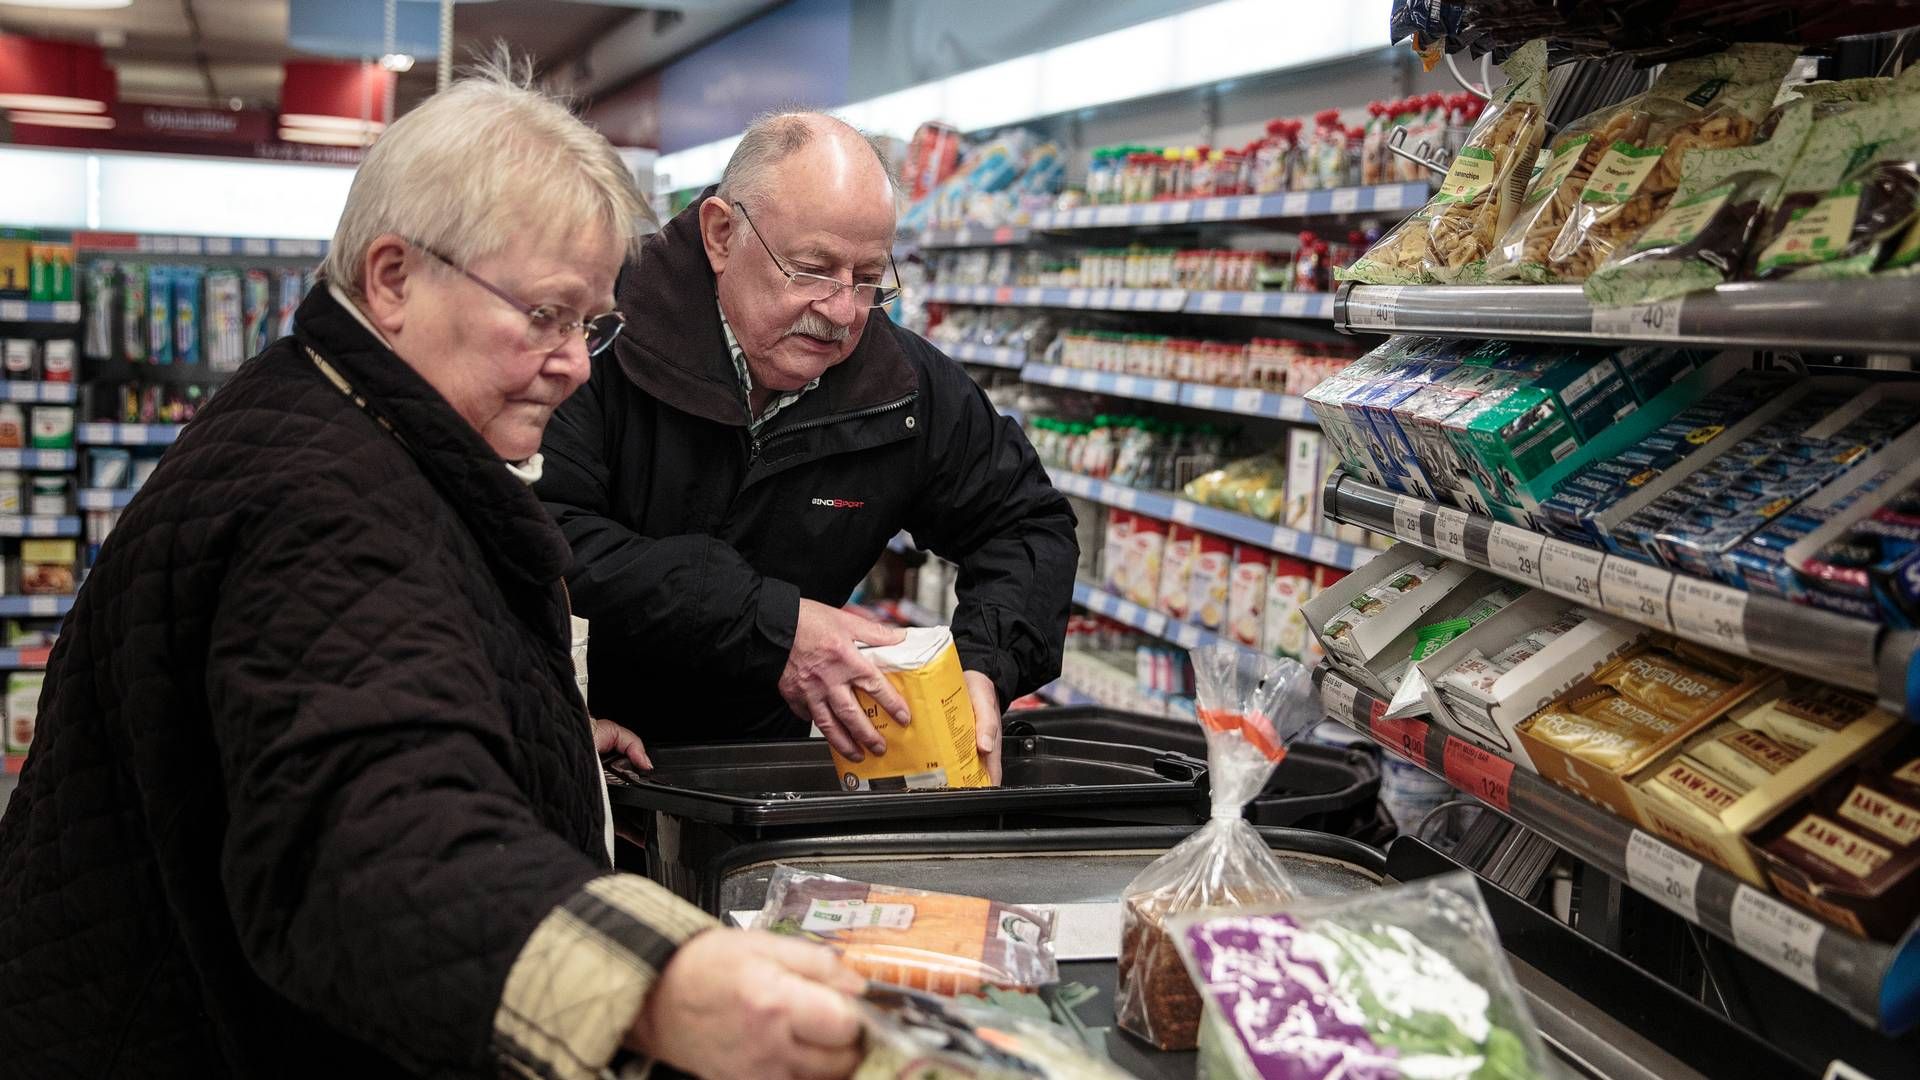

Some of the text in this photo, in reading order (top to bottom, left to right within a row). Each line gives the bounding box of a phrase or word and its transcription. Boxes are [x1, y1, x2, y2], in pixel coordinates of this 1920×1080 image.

[1643, 305, 1664, 328] 40
[1407, 518, 1416, 531] 29
[1448, 532, 1458, 545] 29
[1518, 556, 1531, 574] 29
[1576, 576, 1590, 594] 29
[1639, 596, 1655, 616] 29
[1630, 658, 1708, 697] PROTEIN BAR
[1610, 698, 1655, 728] PROTEIN
[1482, 777, 1496, 800] 12
[1665, 876, 1682, 899] 20
